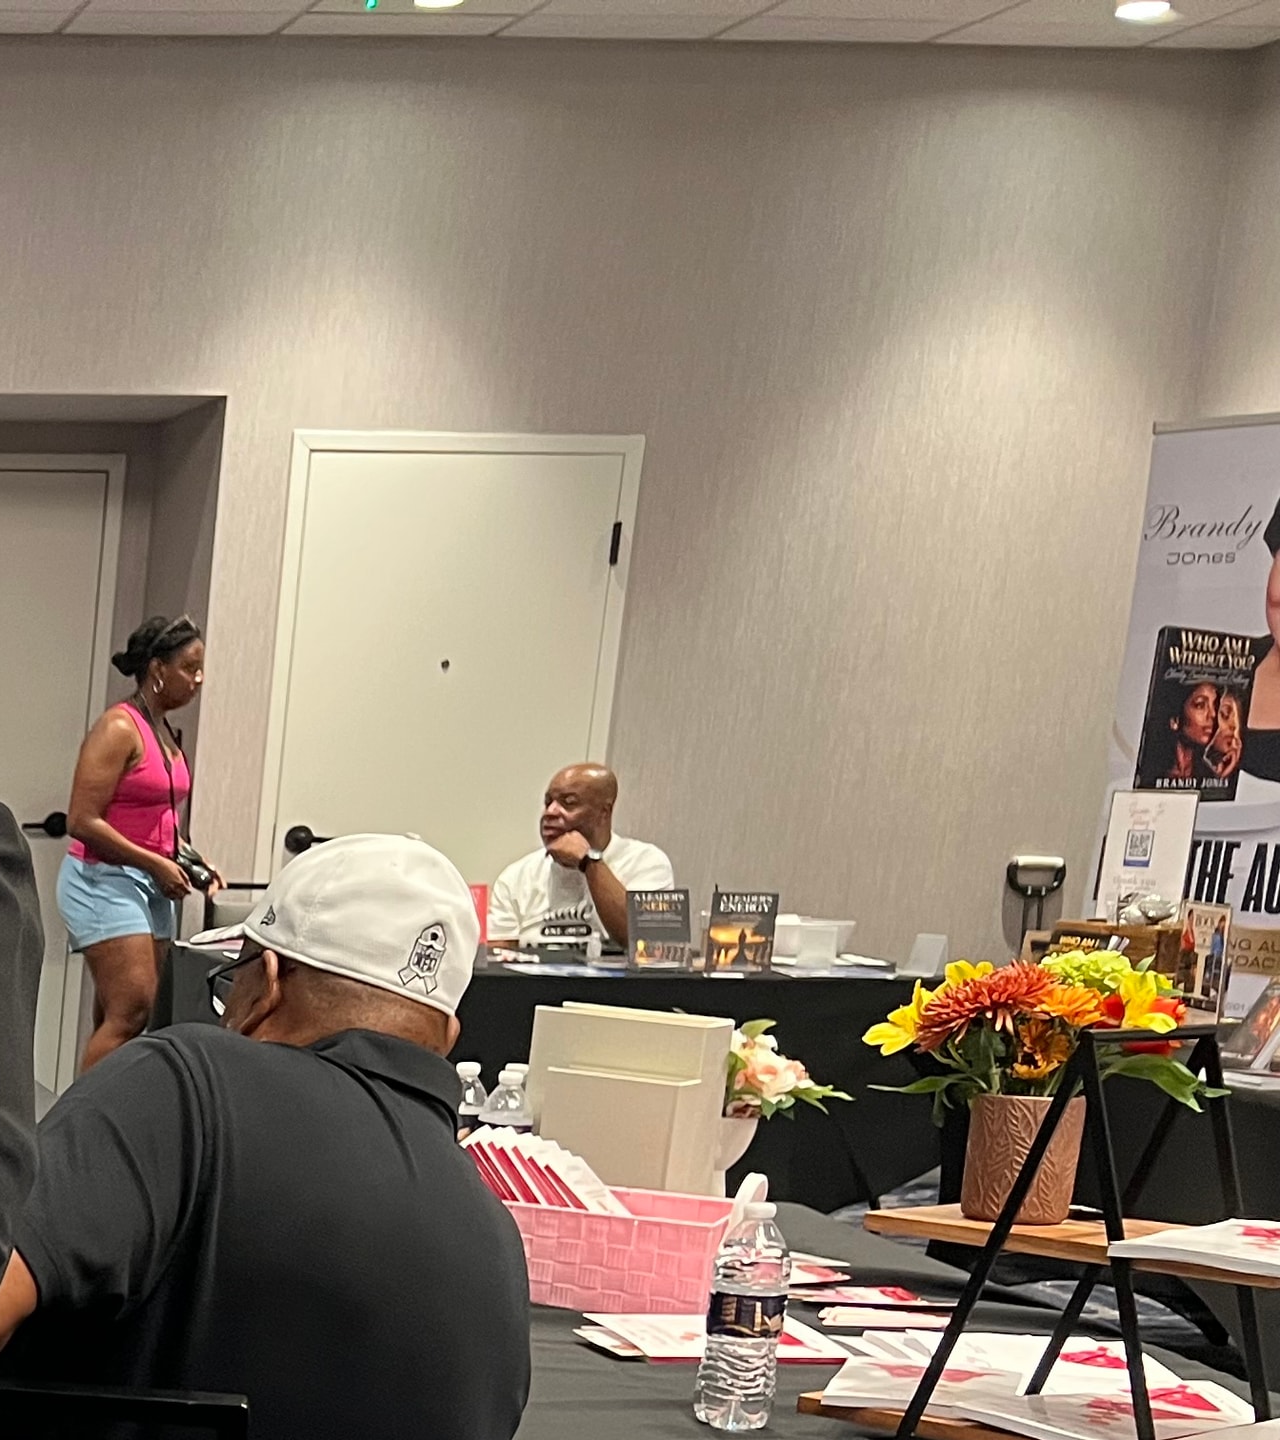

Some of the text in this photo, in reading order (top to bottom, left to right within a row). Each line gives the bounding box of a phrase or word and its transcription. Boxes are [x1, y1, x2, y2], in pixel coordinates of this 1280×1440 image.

[1144, 503, 1264, 549] Brandy
[1181, 630, 1251, 655] WHO AM I
[1169, 647, 1255, 671] WITHOUT YOU?
[1156, 777, 1229, 788] BRANDY JONES
[720, 903, 770, 913] ENERGY
